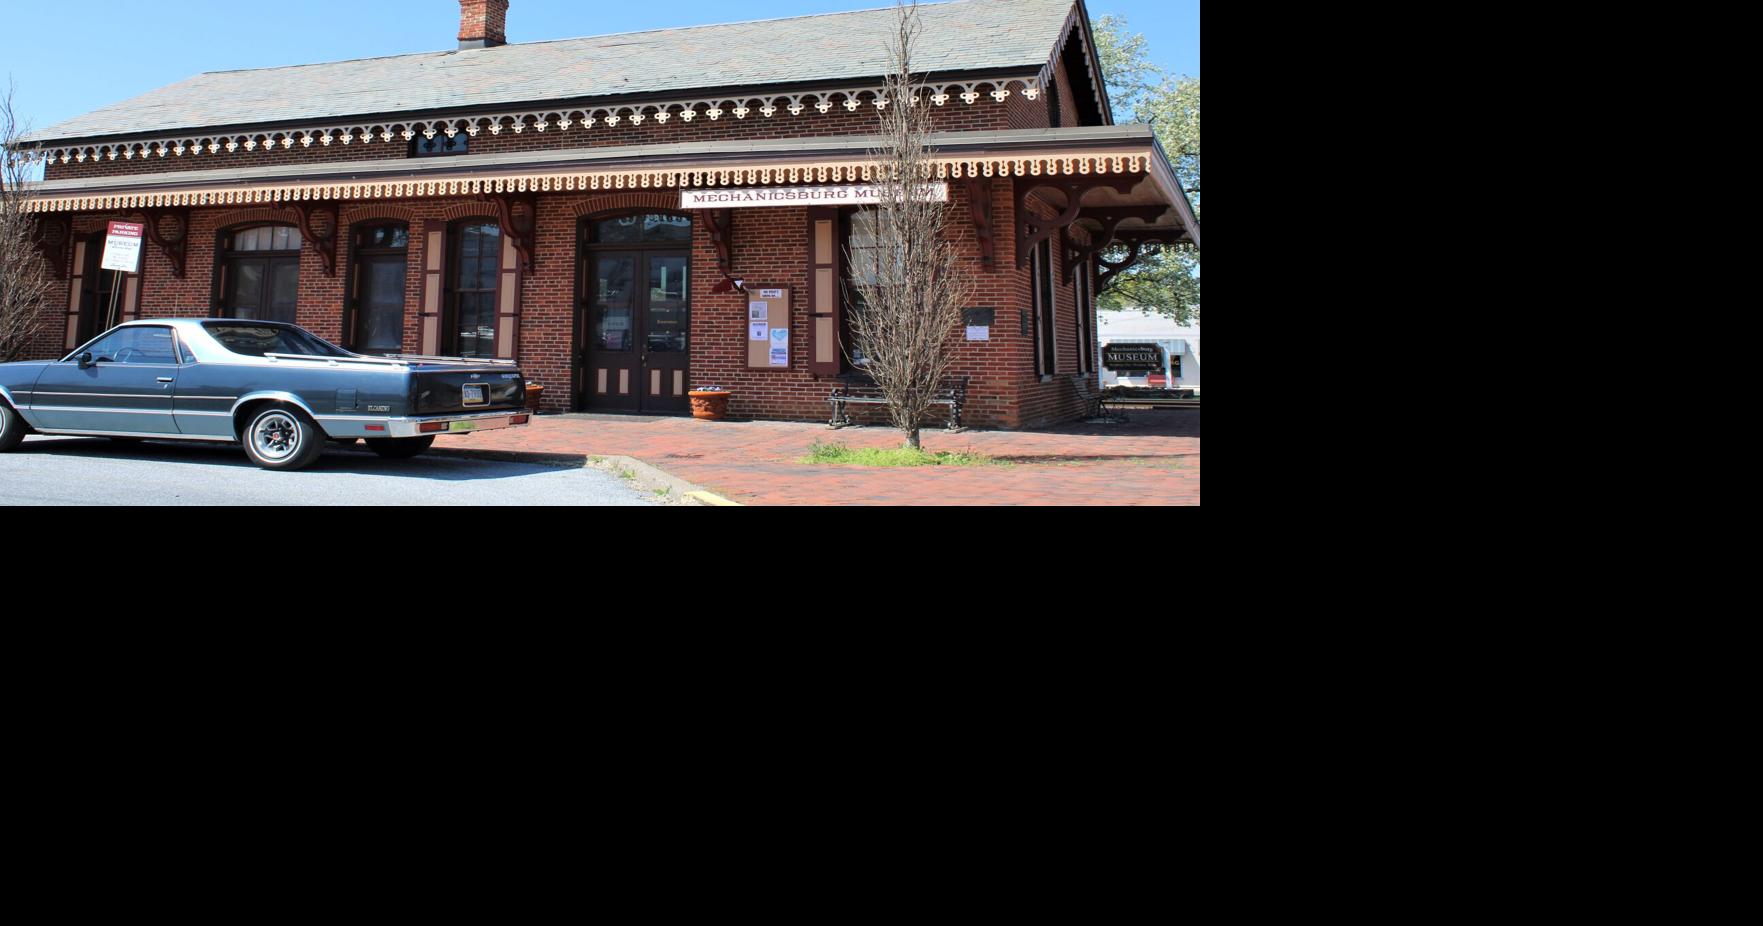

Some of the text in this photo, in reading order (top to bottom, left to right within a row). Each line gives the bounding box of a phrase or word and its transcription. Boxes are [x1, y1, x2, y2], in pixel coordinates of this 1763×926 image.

[693, 187, 934, 203] MECHANICSBURG MUSM
[1108, 353, 1157, 361] MUSEUM
